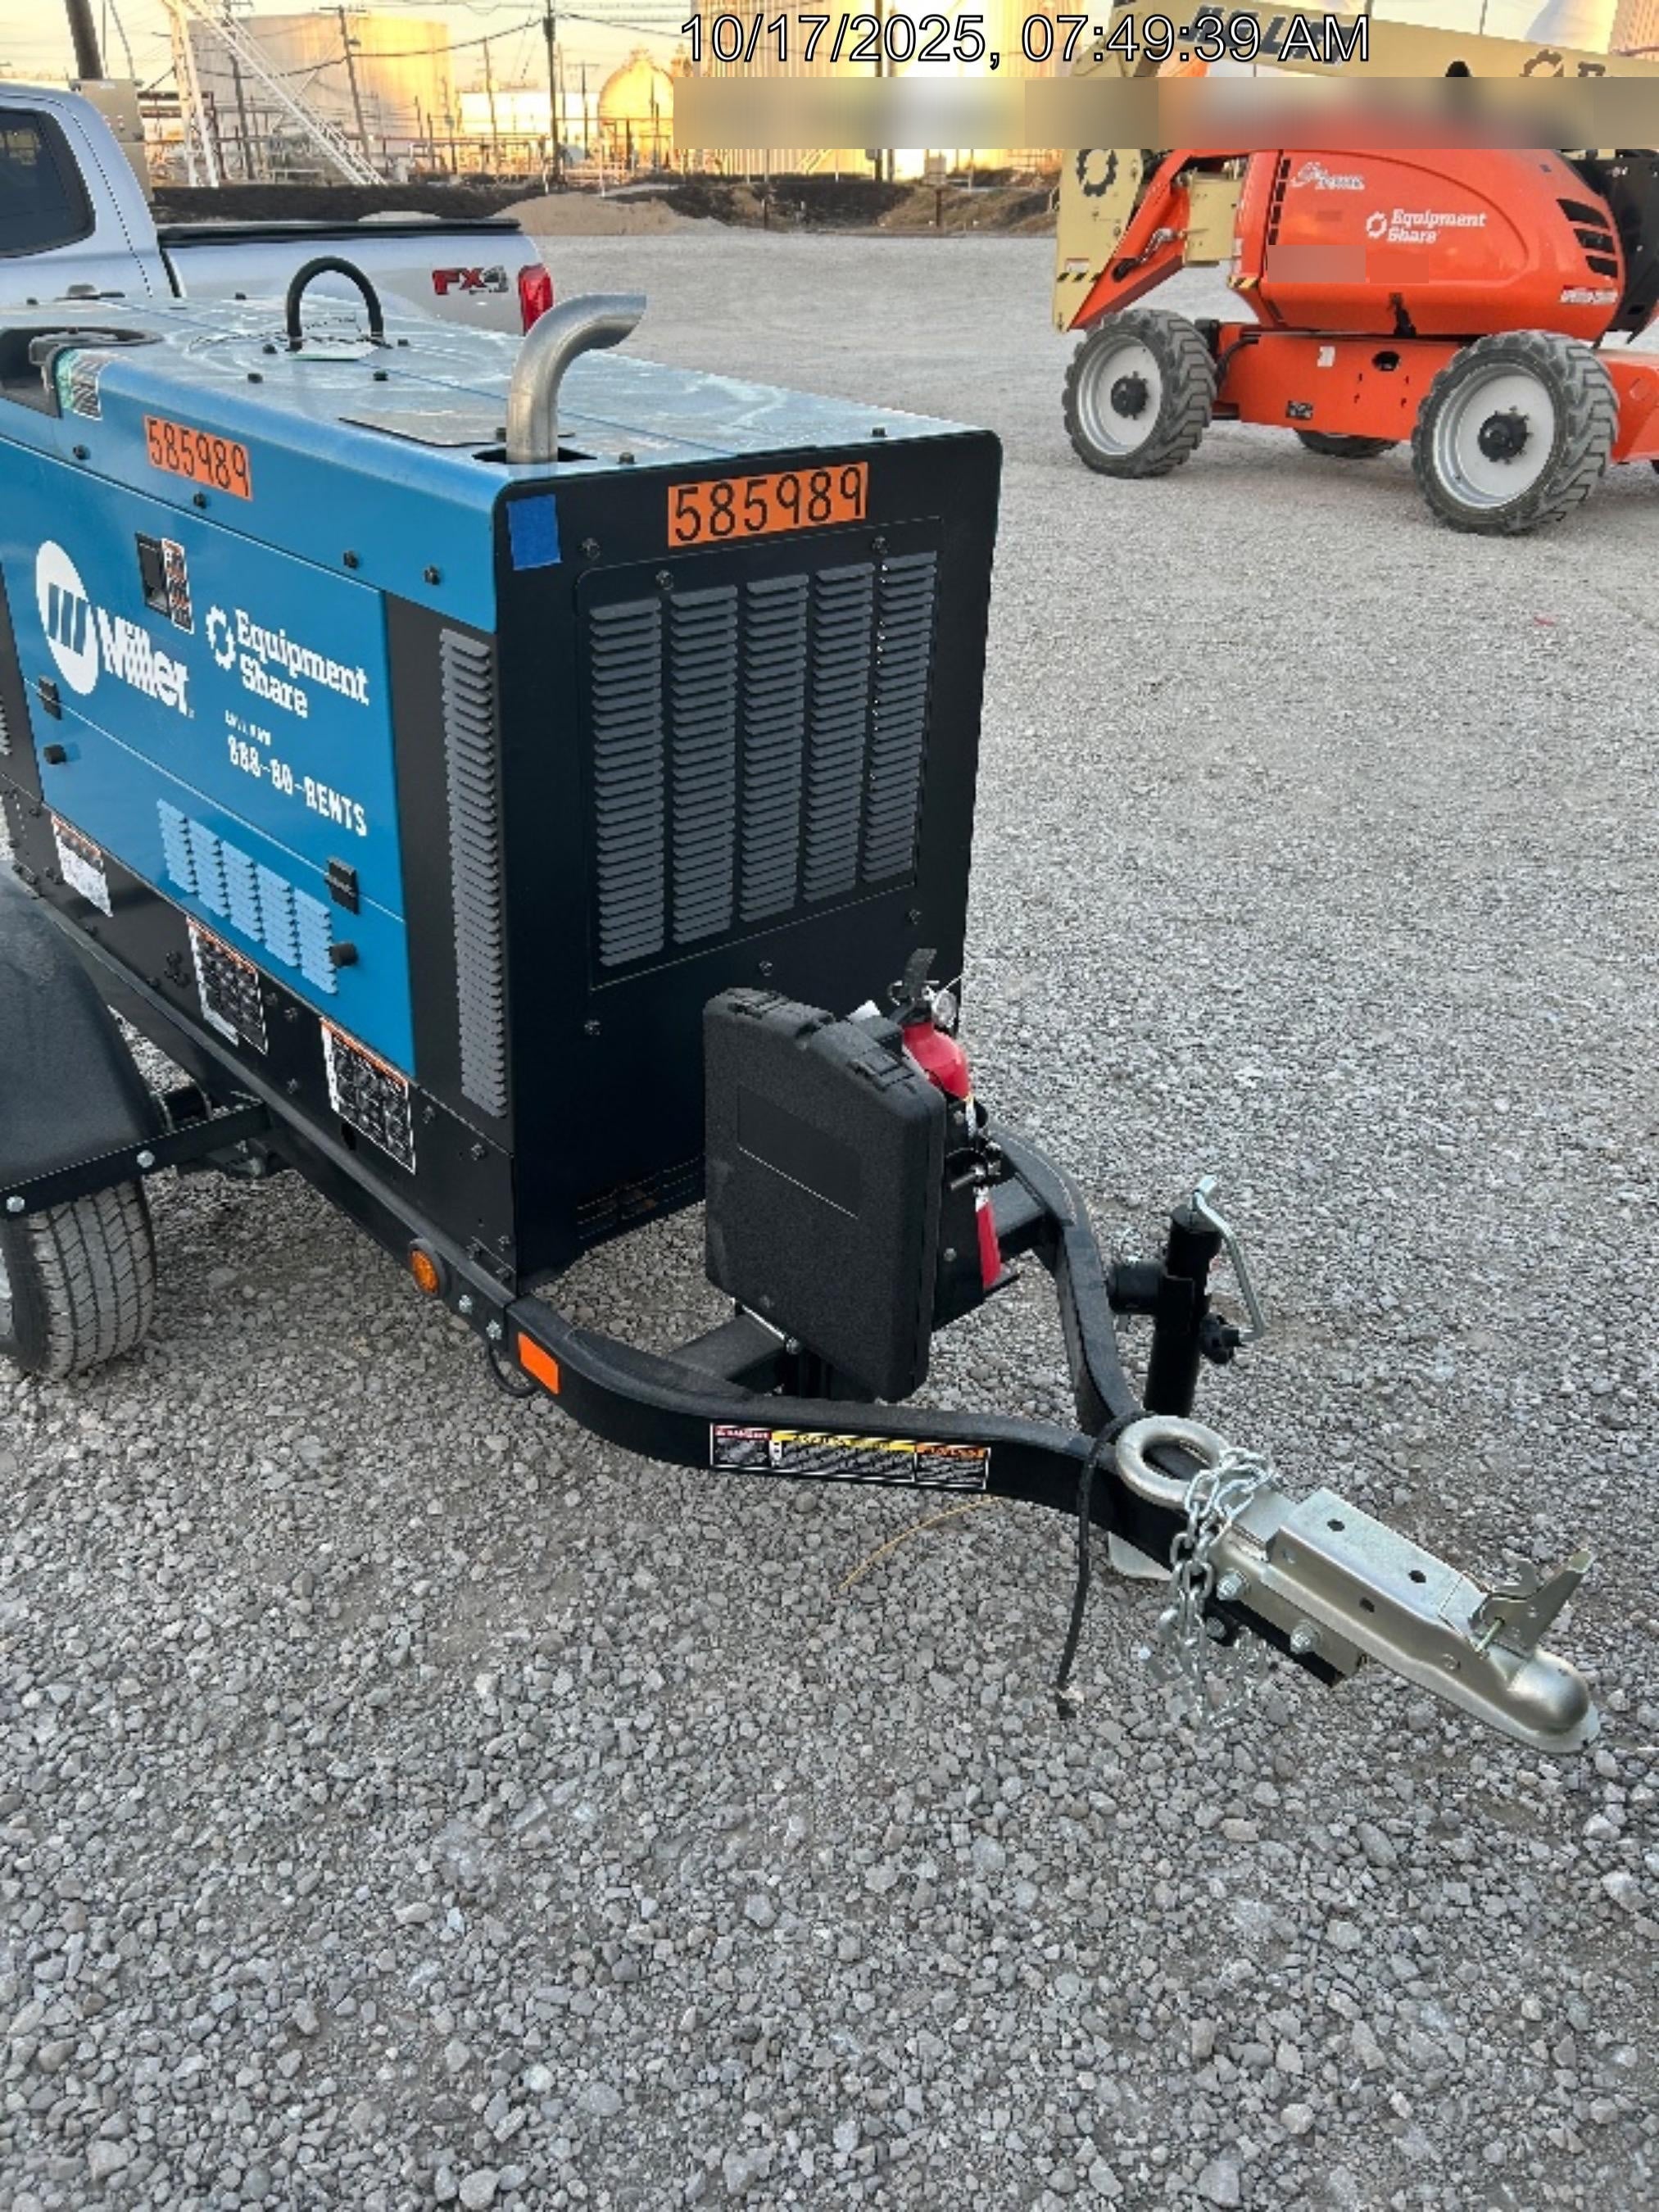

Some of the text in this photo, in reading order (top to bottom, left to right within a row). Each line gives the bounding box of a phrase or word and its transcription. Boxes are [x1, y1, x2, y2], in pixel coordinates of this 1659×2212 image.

[1387, 226, 1436, 243] Share
[1391, 209, 1487, 228] Equipment
[432, 265, 509, 295] FX4
[147, 419, 249, 497] 585989
[675, 467, 861, 542] 585989
[97, 606, 189, 716] Miller
[235, 609, 369, 706] Equipment
[240, 653, 308, 718] Share
